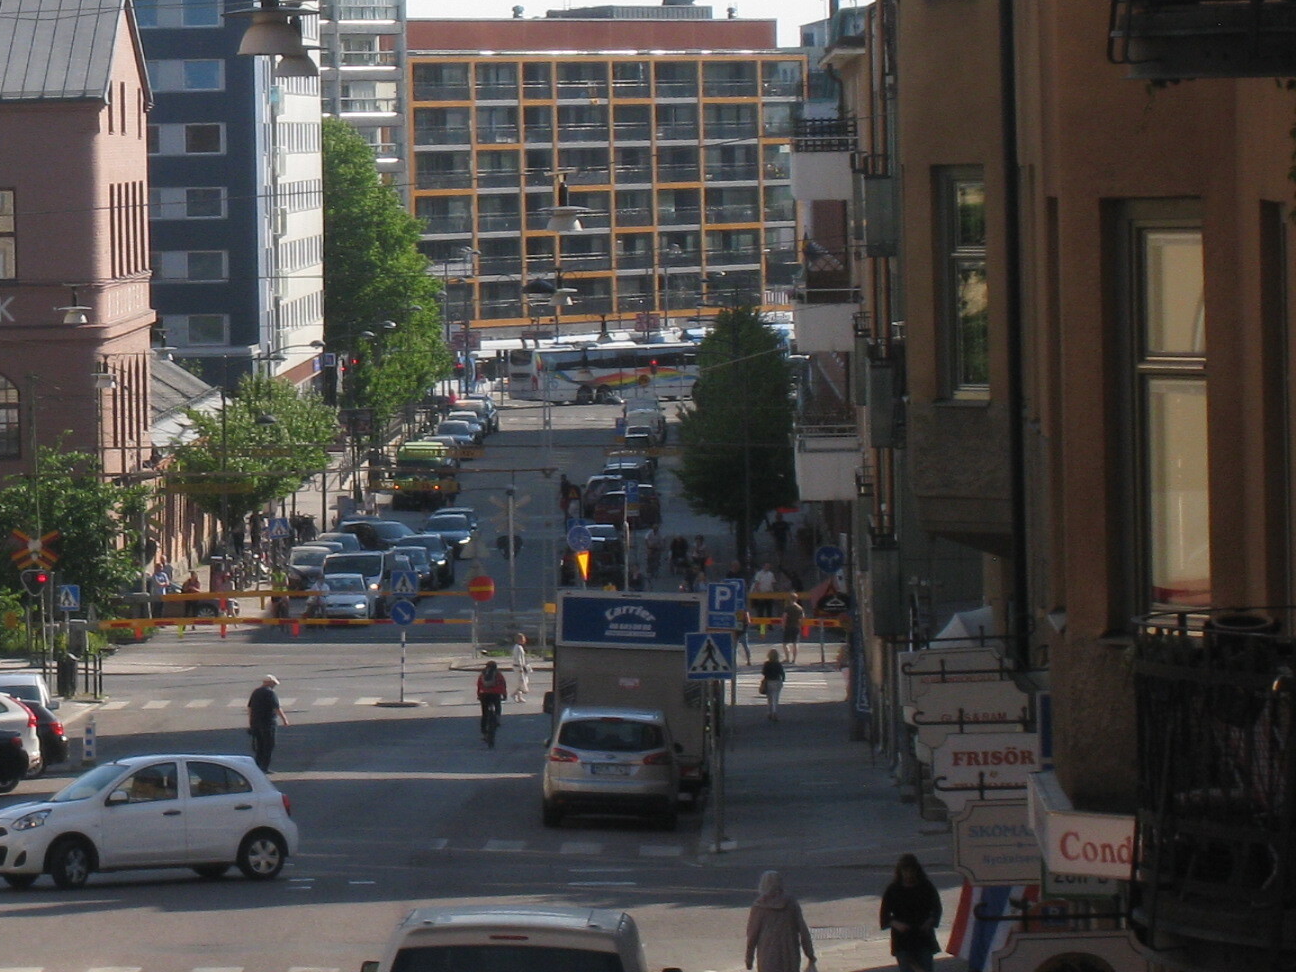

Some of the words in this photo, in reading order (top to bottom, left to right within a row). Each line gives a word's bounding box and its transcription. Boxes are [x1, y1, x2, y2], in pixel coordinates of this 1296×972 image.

[715, 586, 731, 609] P
[952, 747, 1034, 766] FRISÖR
[1060, 831, 1133, 864] Cond
